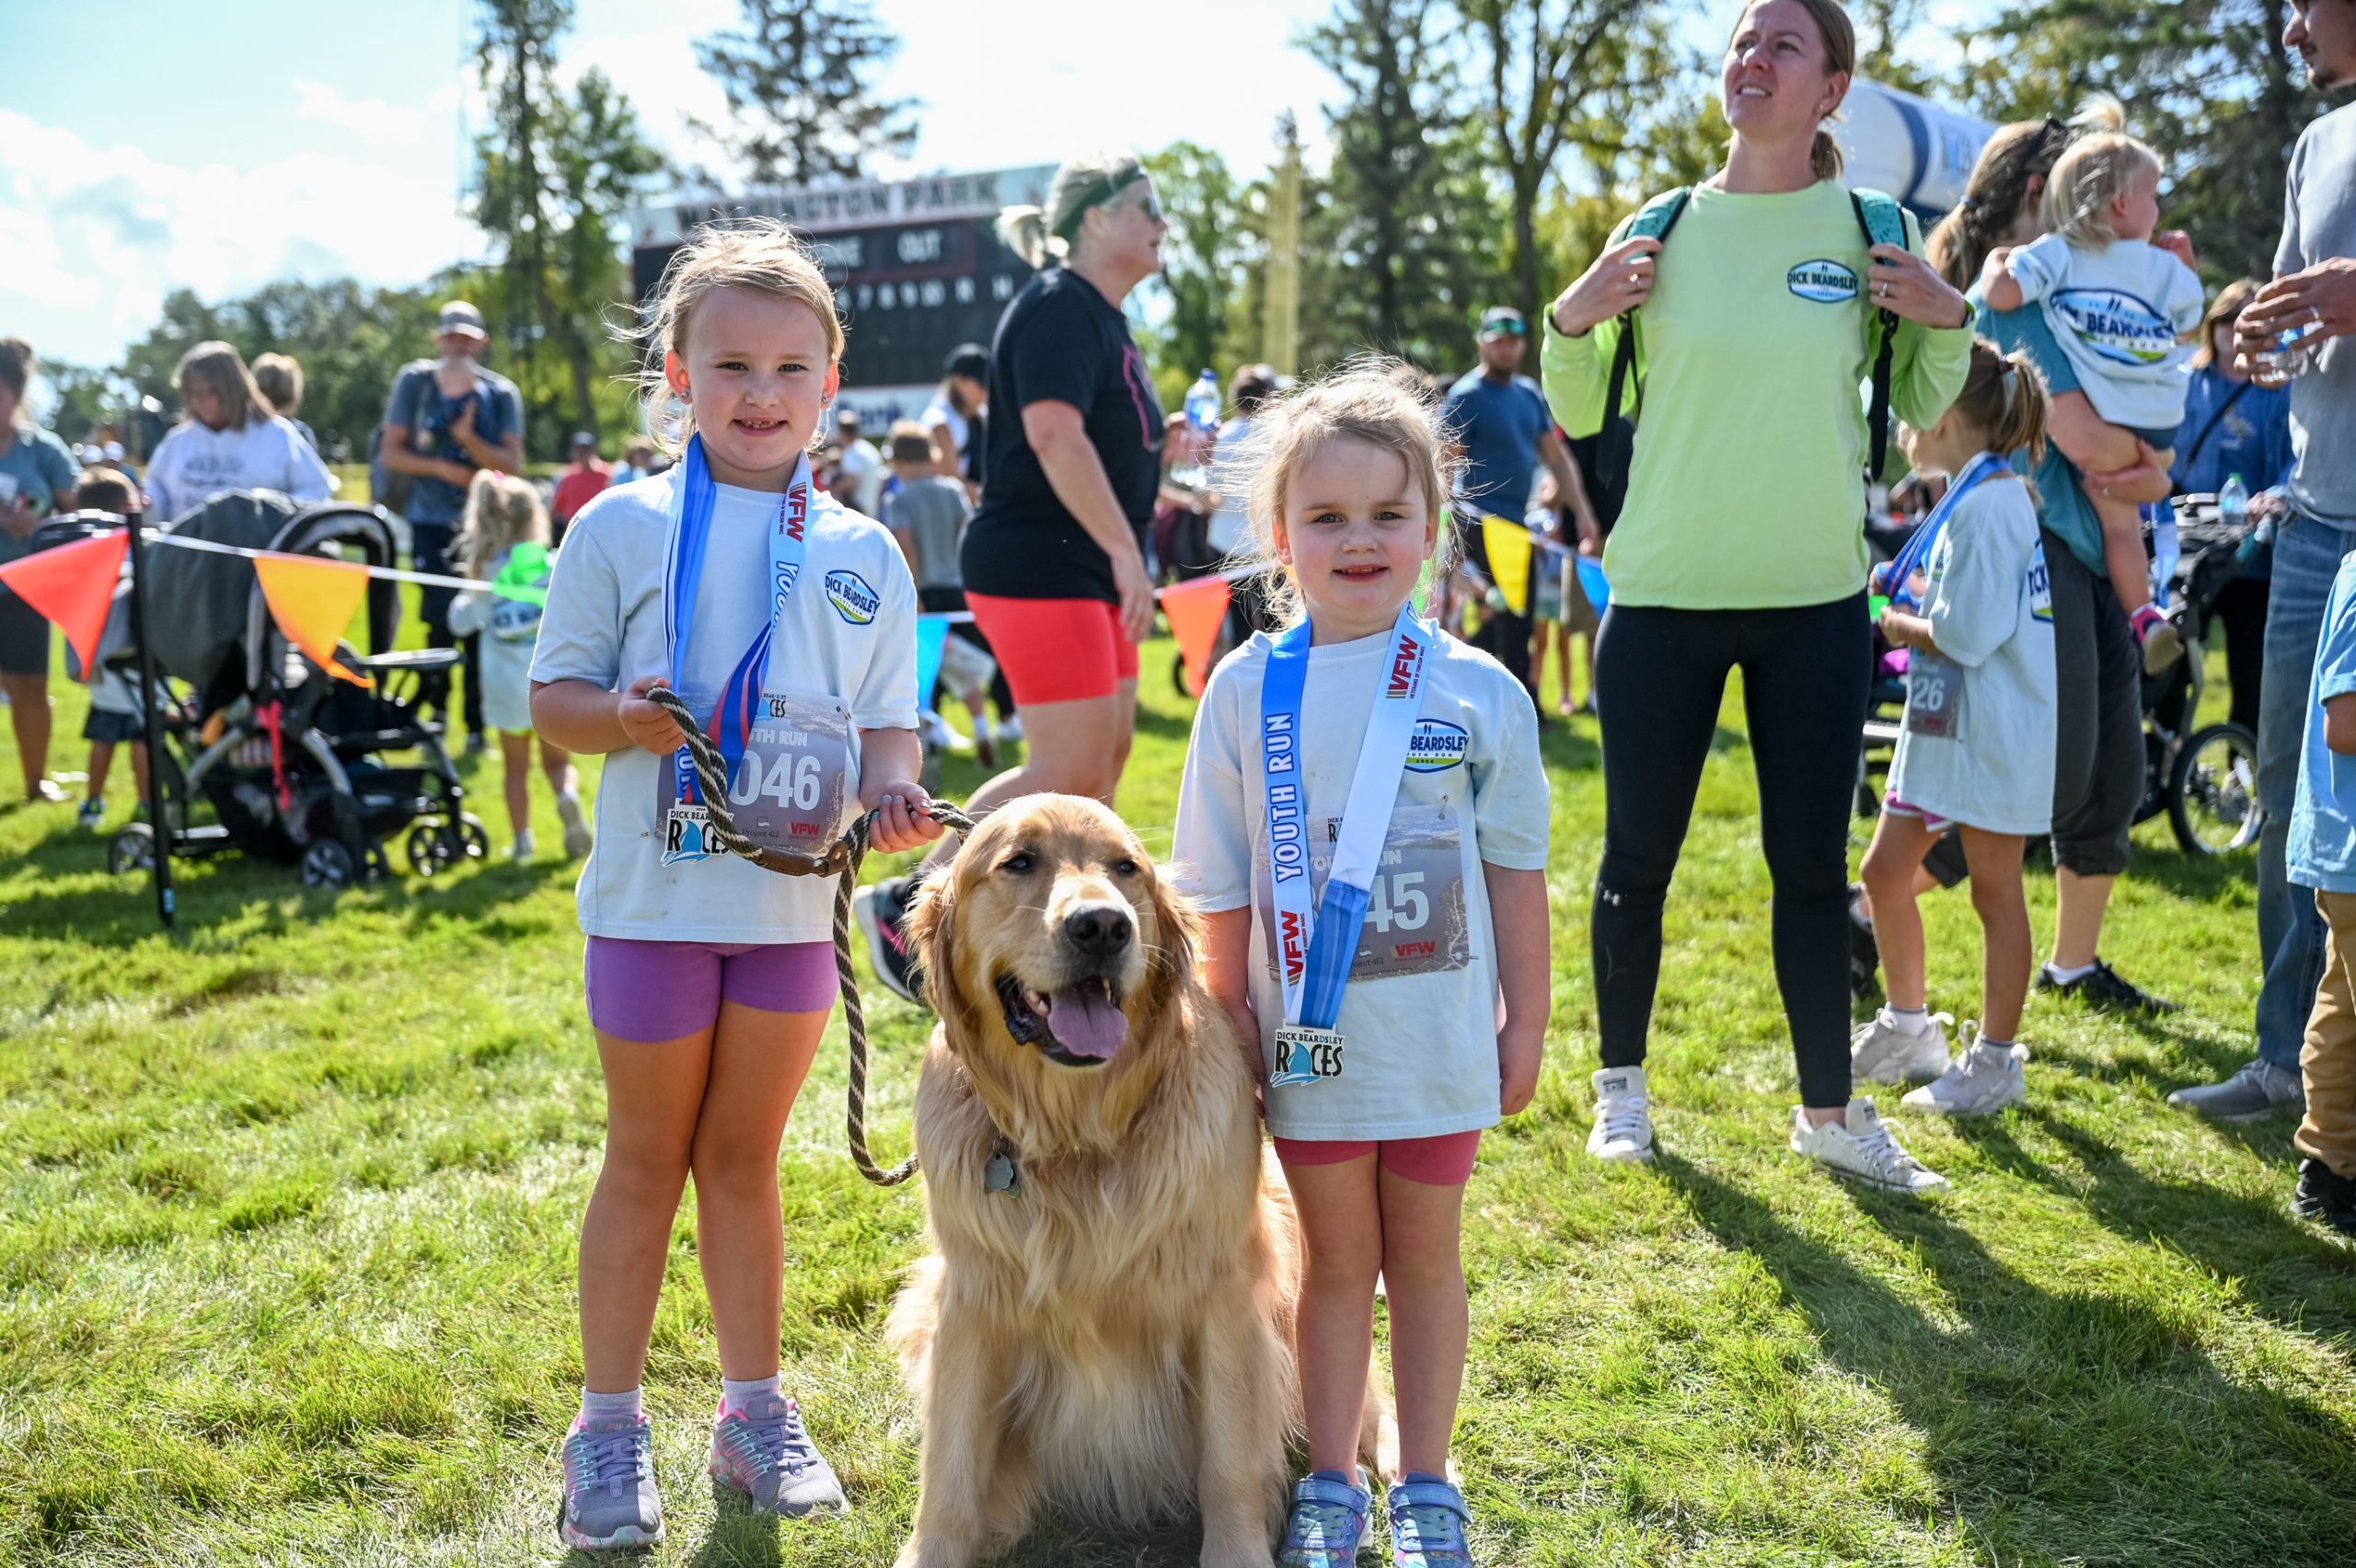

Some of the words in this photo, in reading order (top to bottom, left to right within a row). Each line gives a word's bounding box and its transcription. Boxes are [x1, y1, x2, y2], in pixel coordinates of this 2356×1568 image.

[1787, 271, 1808, 283] DICK
[1811, 273, 1858, 290] BEARDSLEY
[787, 488, 807, 543] VFW
[775, 560, 800, 624] YOU
[825, 574, 842, 595] DICK
[842, 583, 882, 616] BEARDSLEY
[1388, 634, 1418, 690] VFW
[1912, 675, 1945, 711] 26
[779, 730, 808, 746] RUN
[1265, 712, 1294, 775] RUN
[1410, 735, 1470, 752] BEARDSLEY
[670, 811, 689, 819] DICK
[742, 828, 767, 837] Project
[791, 822, 821, 836] VFW
[1269, 783, 1303, 883] YOUTH
[1281, 910, 1303, 977] VFW
[1394, 940, 1436, 957] VFW
[1276, 1032, 1297, 1041] DICK
[1299, 1033, 1344, 1044] BEARDSLEY
